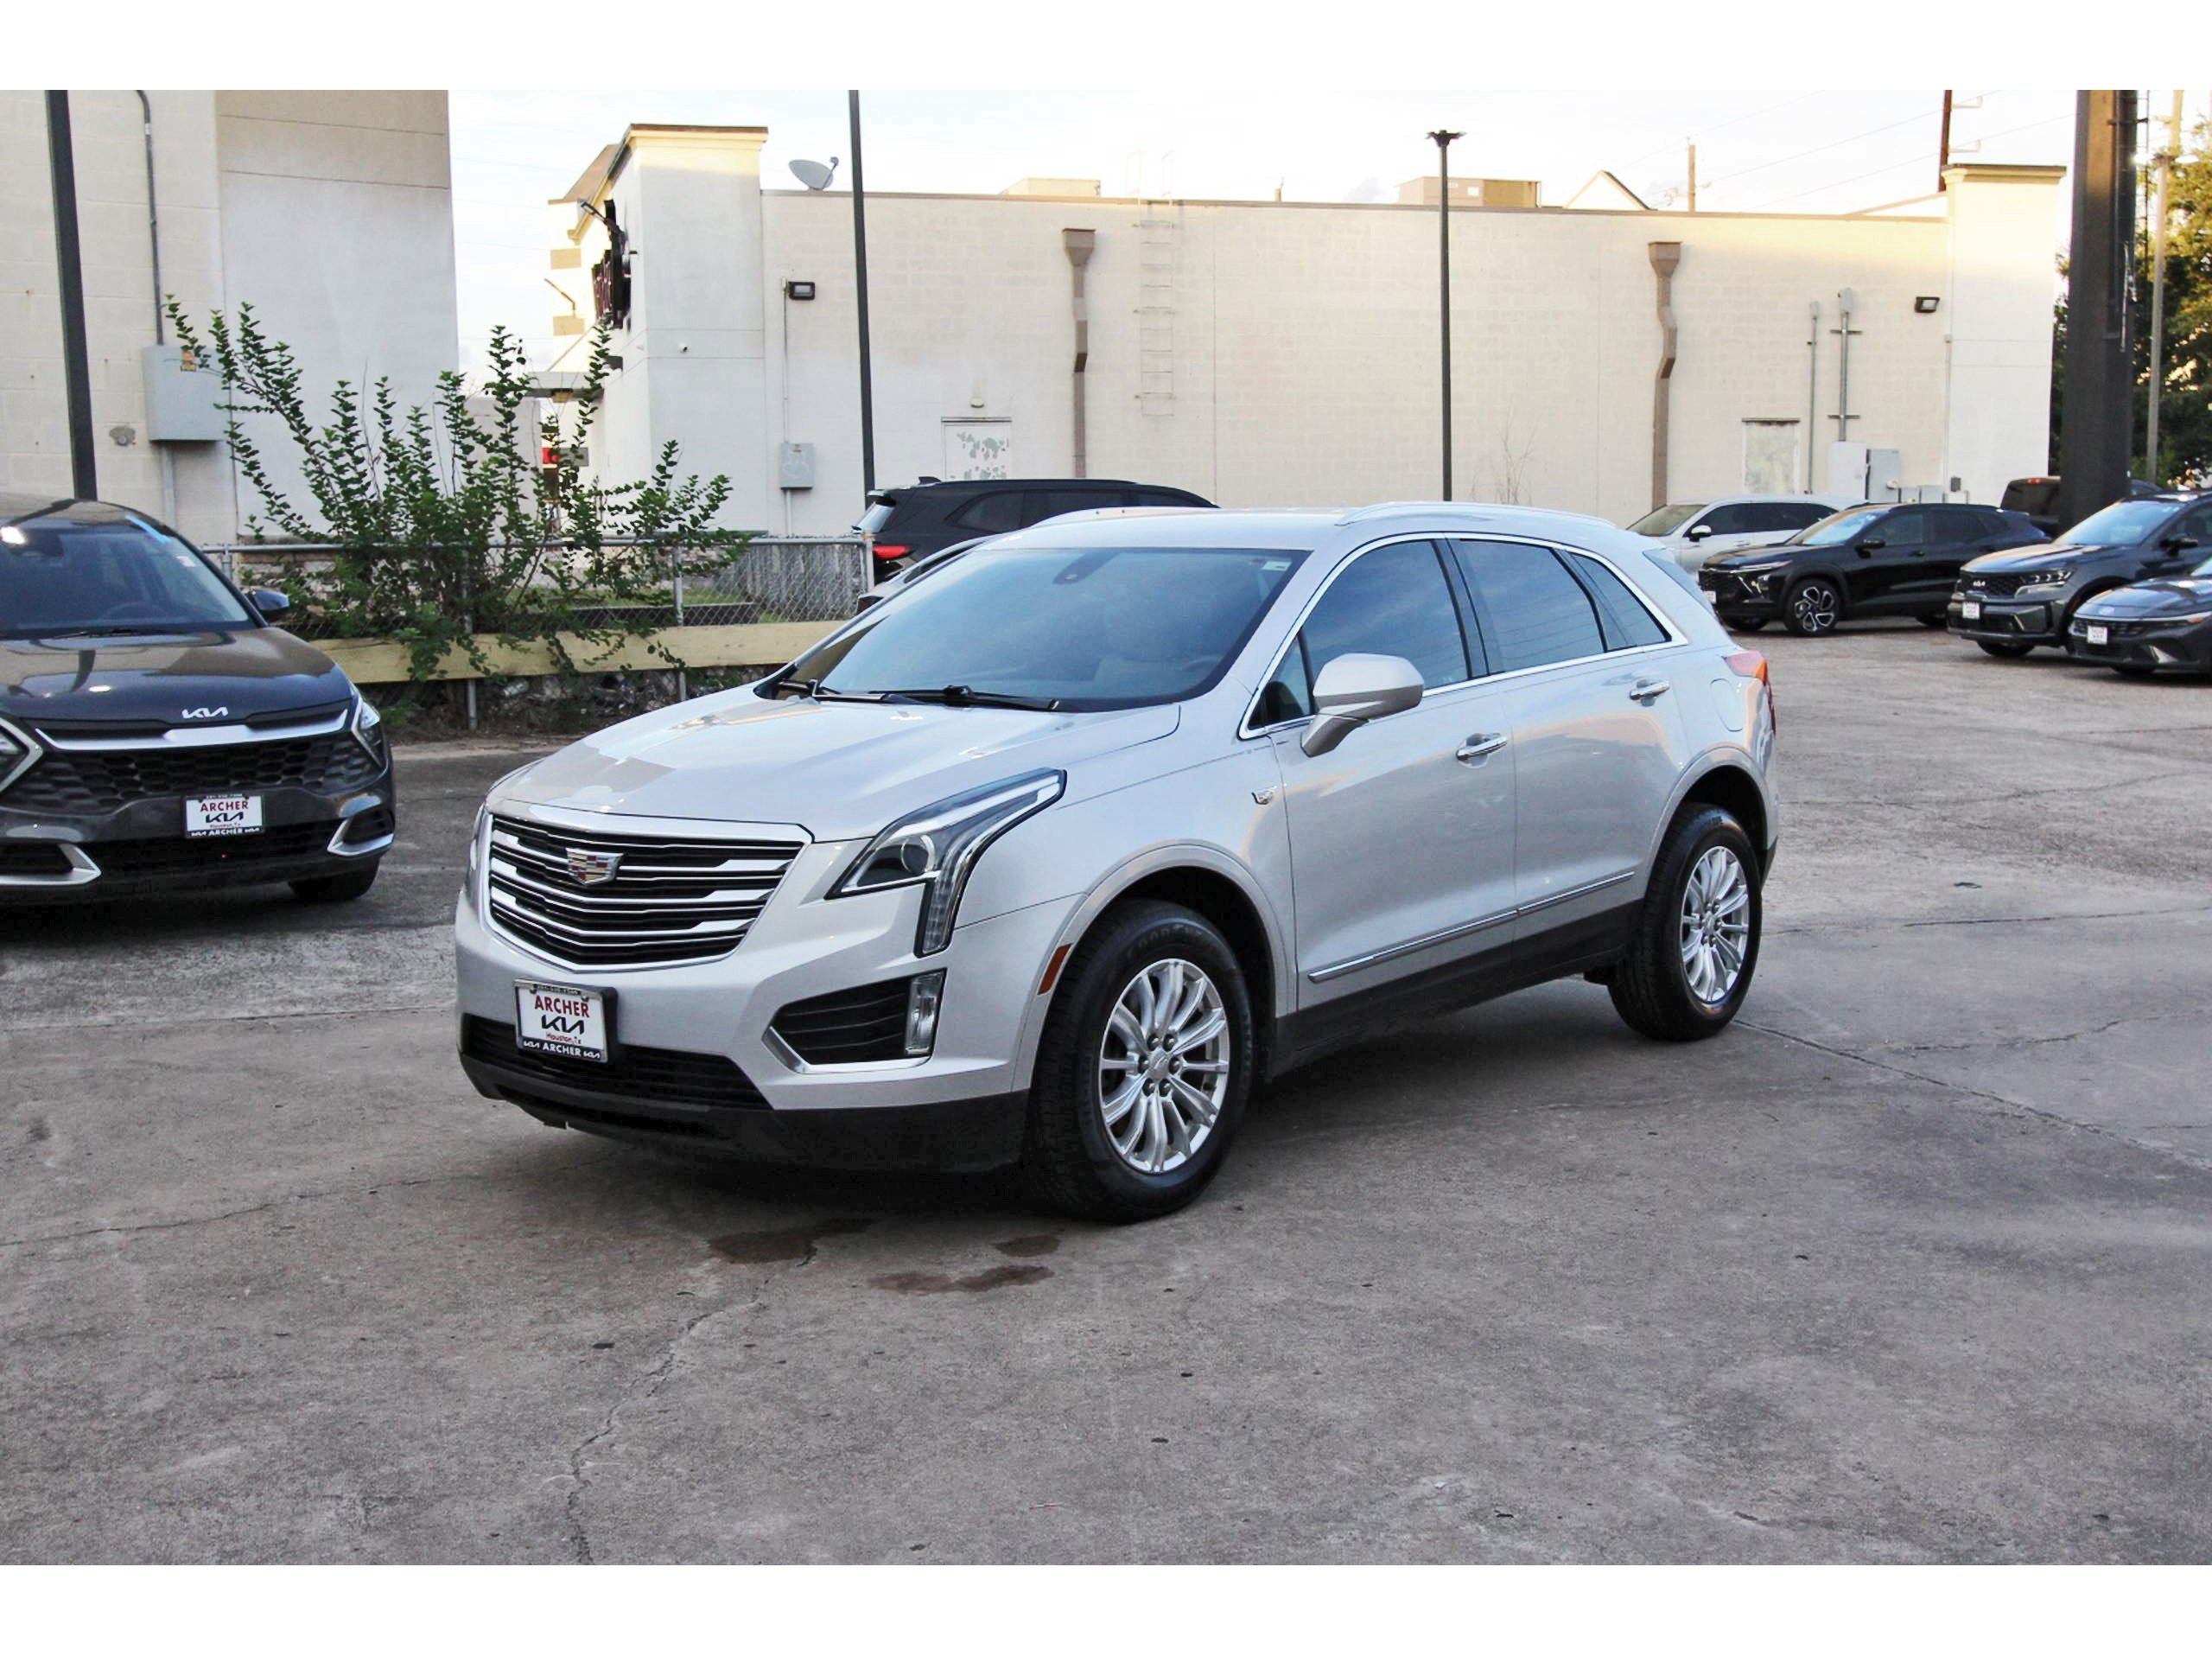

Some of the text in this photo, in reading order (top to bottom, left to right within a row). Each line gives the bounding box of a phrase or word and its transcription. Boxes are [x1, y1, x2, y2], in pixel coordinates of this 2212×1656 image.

[181, 706, 229, 719] KIA
[200, 801, 249, 812] ARCHER
[206, 811, 244, 824] KIA
[535, 995, 590, 1018] ARCHER
[541, 1014, 585, 1035] KIA
[543, 1042, 582, 1056] ARCHER
